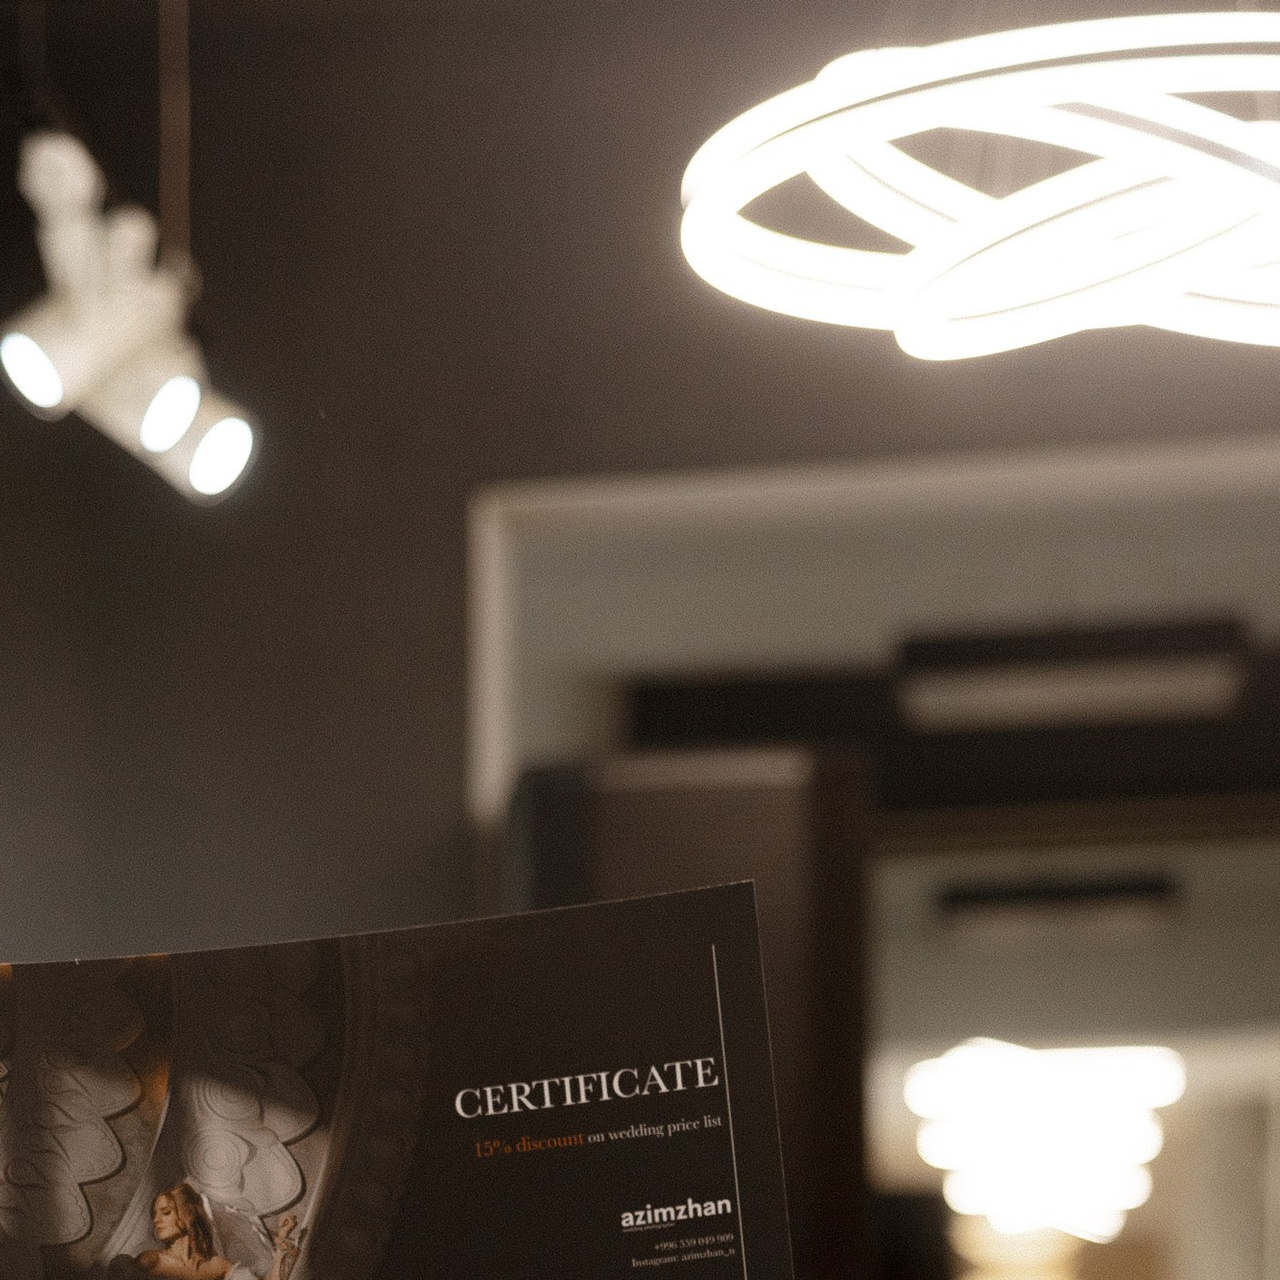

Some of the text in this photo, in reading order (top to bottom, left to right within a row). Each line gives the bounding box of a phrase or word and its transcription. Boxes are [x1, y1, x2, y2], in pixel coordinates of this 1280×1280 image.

[454, 1057, 719, 1119] CERTIFICATE
[474, 1113, 722, 1159] 15% discount on wedding price list
[620, 1197, 732, 1228] azimzhan
[631, 1248, 736, 1268] Instagram: azimzhan_n
